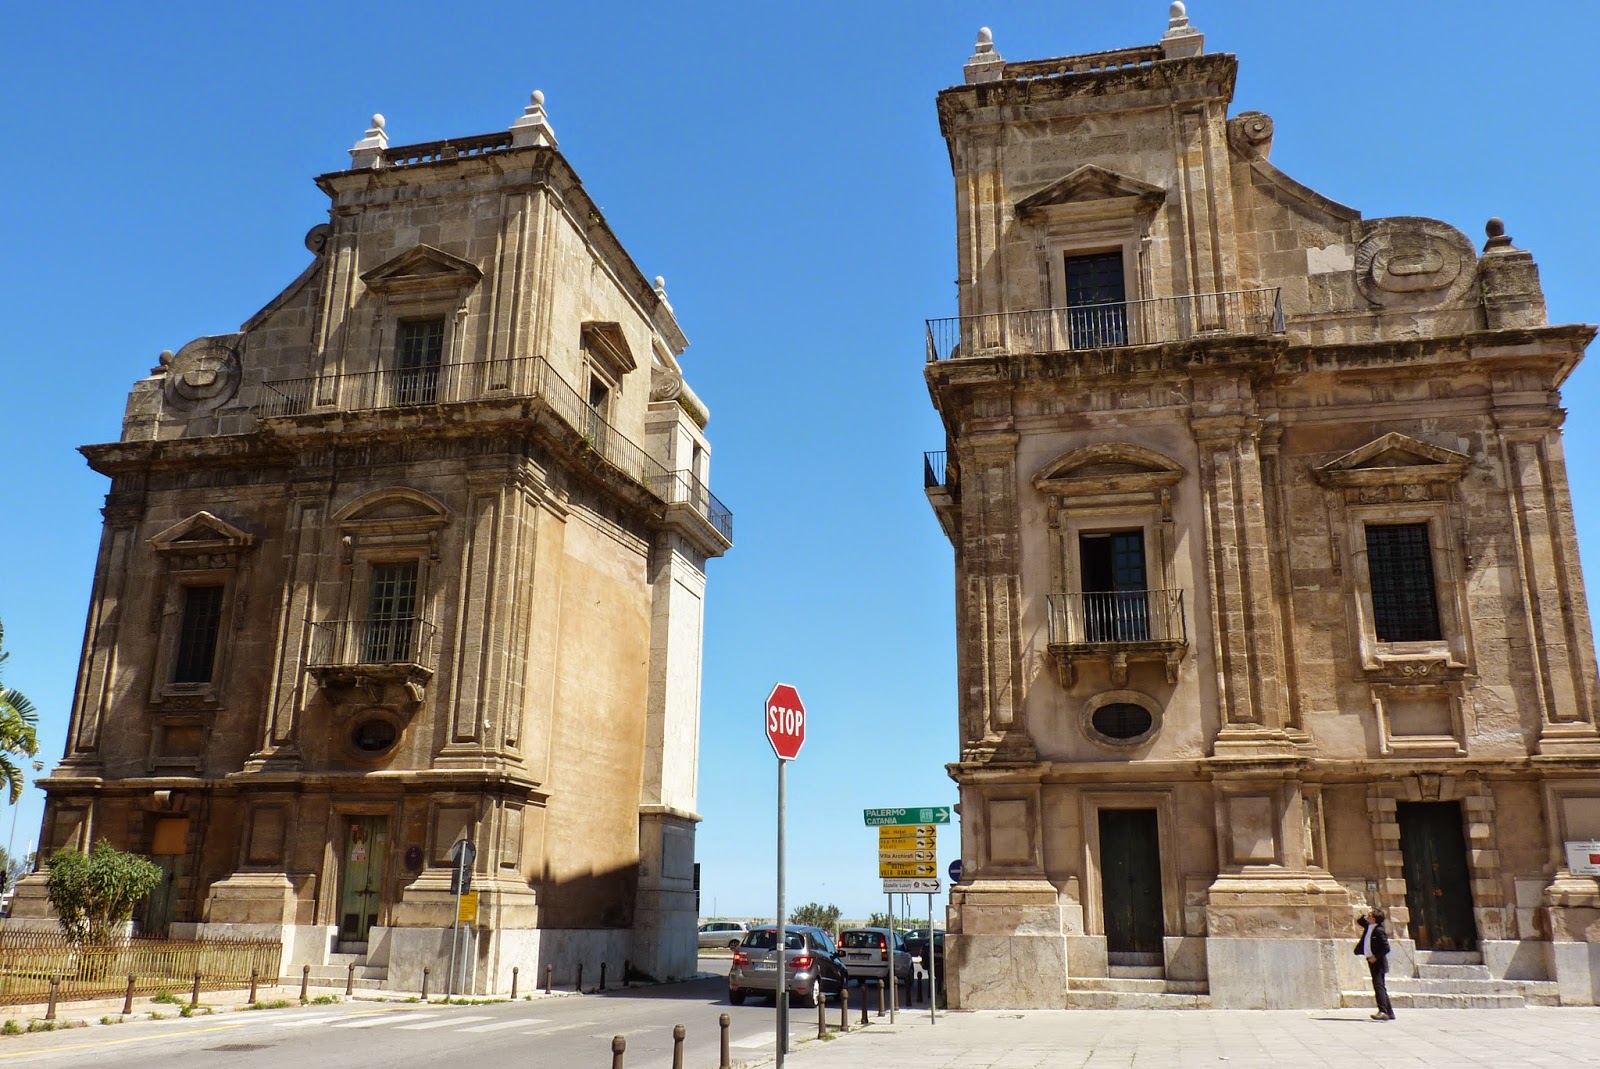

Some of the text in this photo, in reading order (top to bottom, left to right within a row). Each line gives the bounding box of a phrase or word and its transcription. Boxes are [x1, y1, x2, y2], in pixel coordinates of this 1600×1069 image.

[769, 705, 803, 737] STOP
[866, 809, 906, 817] PALERMO
[866, 817, 897, 825] CATANIA
